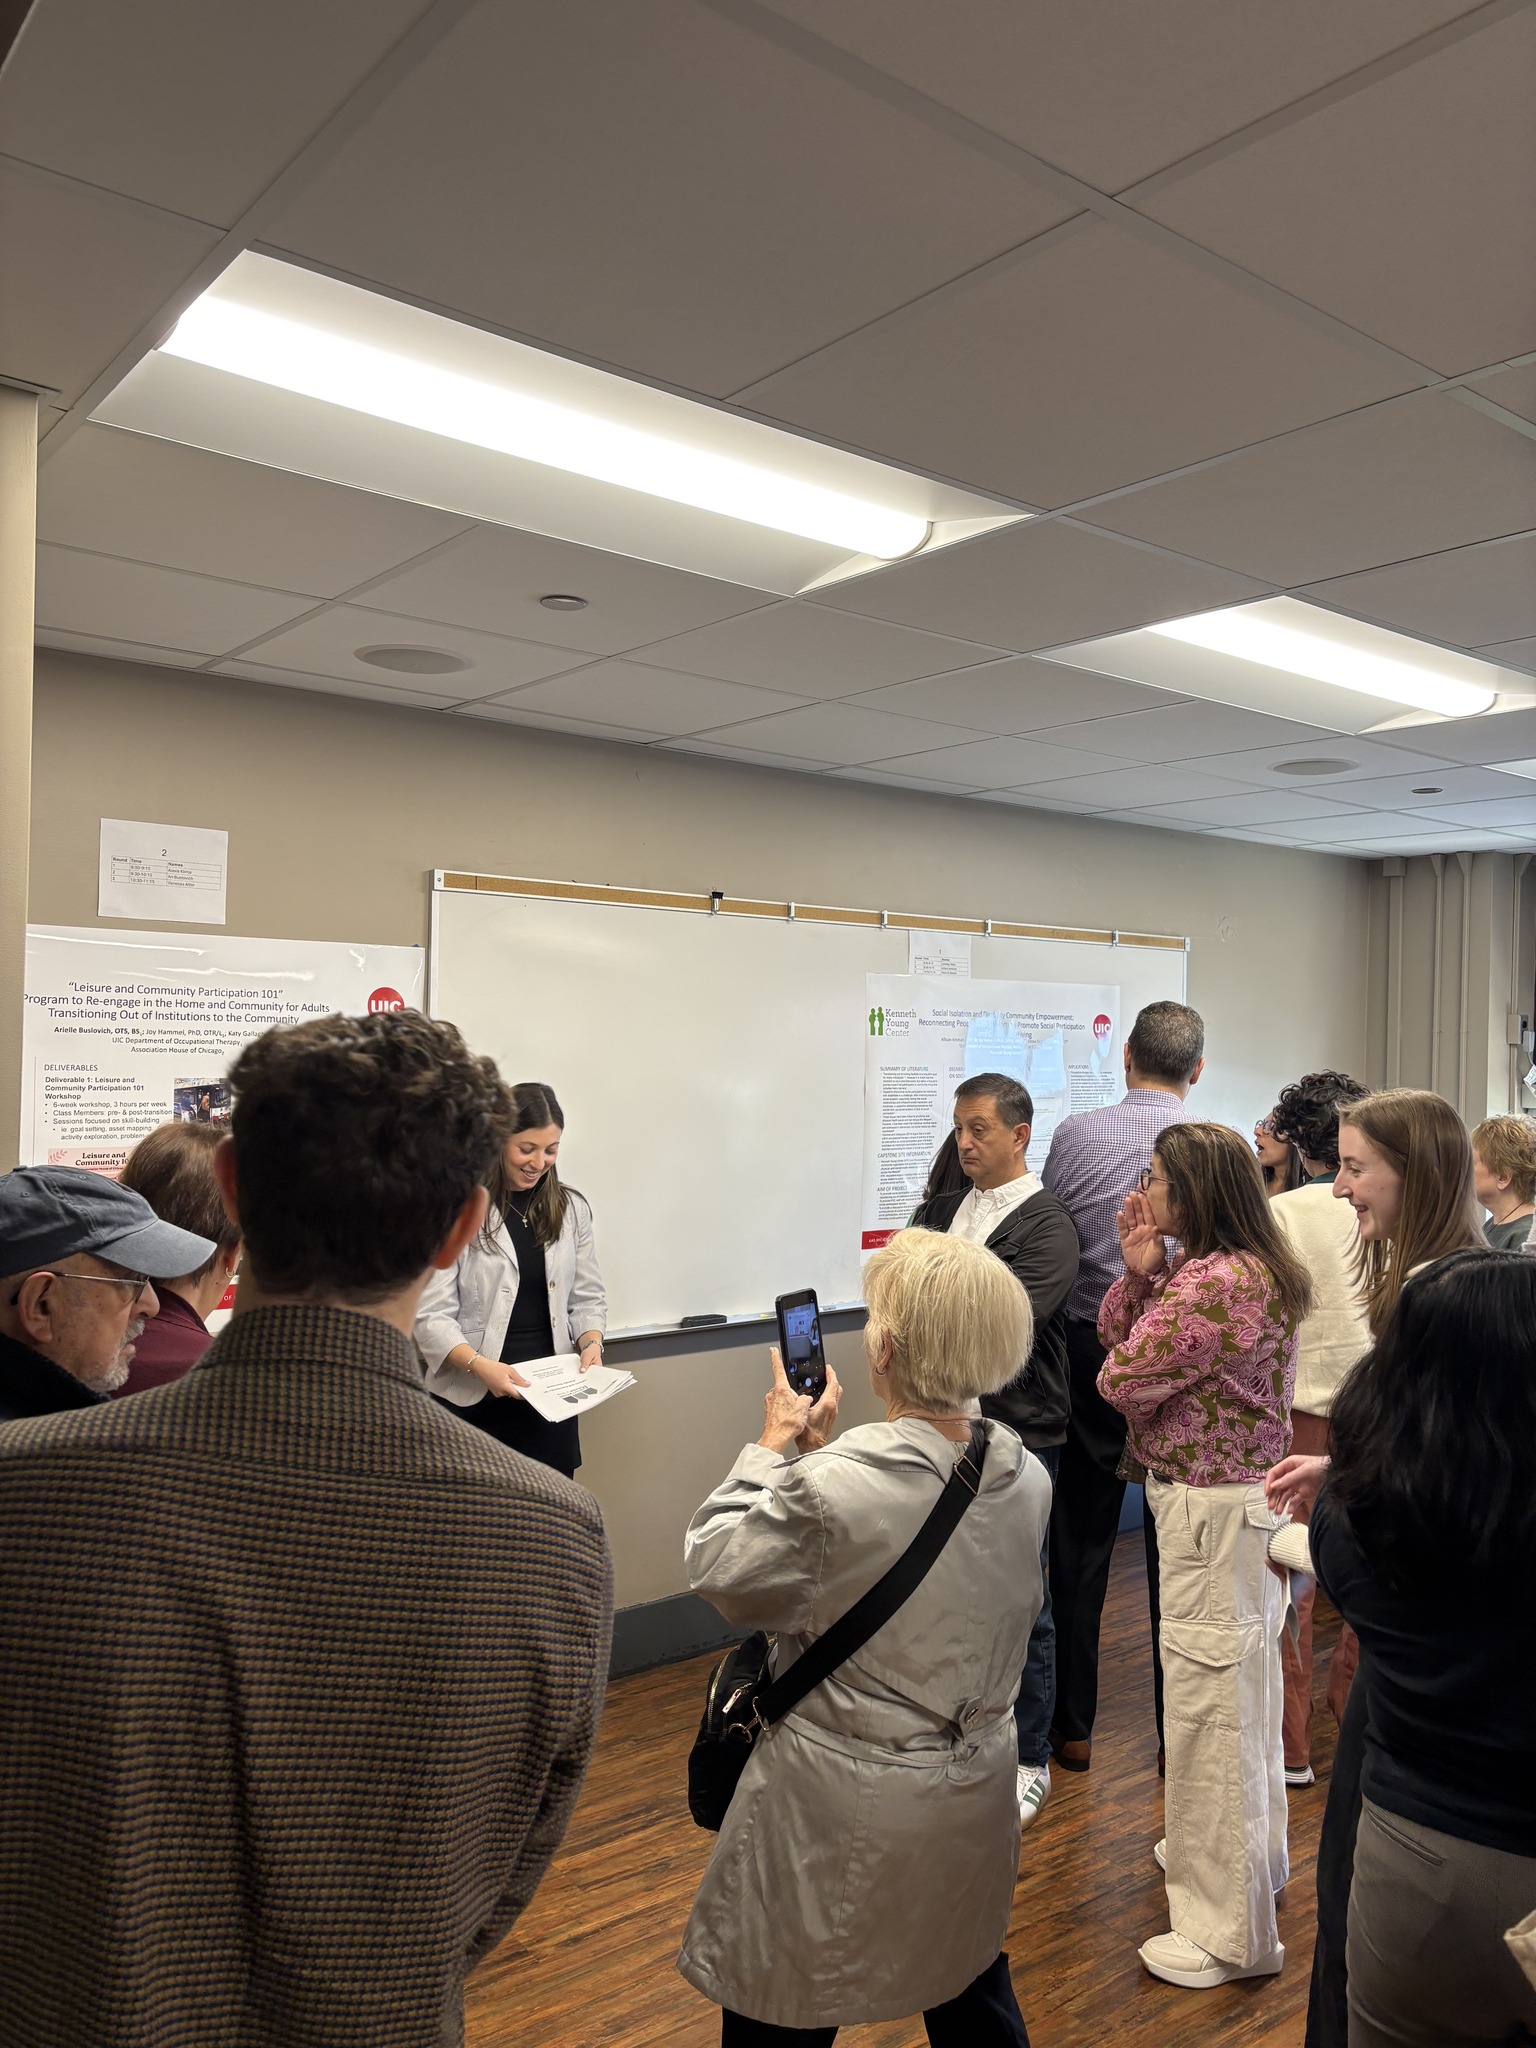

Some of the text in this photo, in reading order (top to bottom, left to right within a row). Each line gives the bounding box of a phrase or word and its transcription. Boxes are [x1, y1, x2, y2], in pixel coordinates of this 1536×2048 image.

[114, 983, 134, 994] and
[137, 984, 196, 997] Community
[198, 987, 259, 999] Participation
[72, 996, 83, 1005] to
[86, 996, 140, 1008] Re-engage
[144, 998, 152, 1007] in
[155, 998, 172, 1008] the
[175, 1000, 205, 1009] Home
[208, 1000, 225, 1010] and
[228, 1001, 284, 1013] Community
[286, 1002, 299, 1012] for
[301, 1003, 330, 1013] Adults
[371, 1000, 402, 1013] UIC
[48, 1008, 299, 1025] Transitioning Out of Institutions to the Community
[885, 1009, 916, 1018] Kenneth
[1006, 1012, 1035, 1020] Community
[1036, 1013, 1074, 1021] Empowerment:
[886, 1018, 909, 1029] Young
[919, 1019, 955, 1028] Reconnecting
[1095, 1024, 1110, 1033] UIC
[886, 1028, 909, 1036] Center
